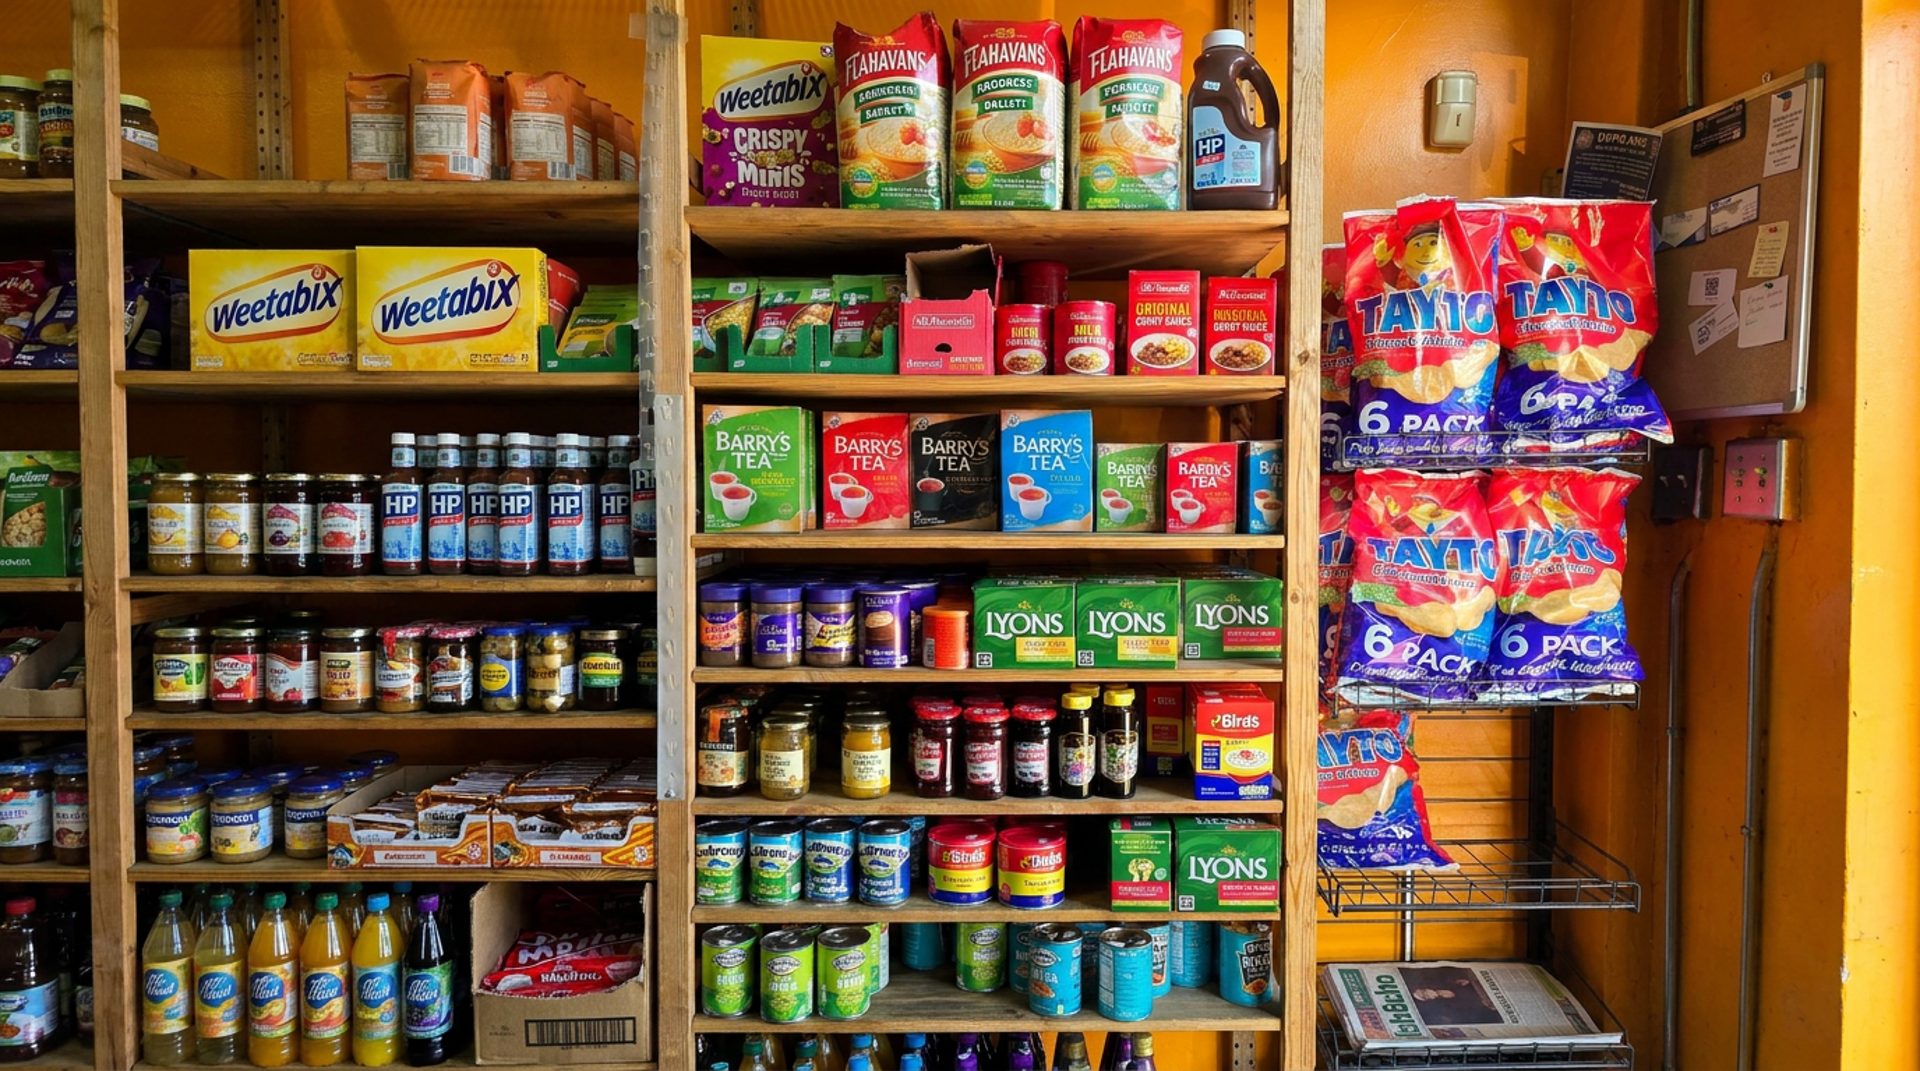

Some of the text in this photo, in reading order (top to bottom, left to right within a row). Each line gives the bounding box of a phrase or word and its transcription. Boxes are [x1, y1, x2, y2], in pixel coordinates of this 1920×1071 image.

[1088, 45, 1172, 79] FLAHAVANS
[719, 71, 826, 114] Weetabix
[733, 128, 809, 154] CRISPY
[1198, 137, 1224, 156] HP
[737, 160, 806, 188] MINIS
[212, 276, 345, 333] Weetabix
[381, 274, 521, 333] Weetabix
[1358, 401, 1485, 435] 6 PACK
[731, 452, 772, 470] TEA
[850, 455, 885, 471] TEA
[936, 456, 971, 472] TEA
[1028, 455, 1066, 471] TEA
[1117, 475, 1145, 489] TEA
[1188, 475, 1218, 489] TEA
[385, 494, 417, 515] HP
[431, 494, 461, 515] HP
[501, 494, 531, 515] HP
[550, 494, 580, 515] HP
[602, 495, 630, 515] HP
[984, 611, 1064, 640] LYONS
[1087, 610, 1167, 639] LYONS
[1195, 603, 1269, 631] LYONS
[1364, 623, 1394, 660] 6
[1401, 642, 1477, 674] PACK
[1500, 623, 1624, 659] 6 PACK
[1188, 855, 1268, 884] LYONS
